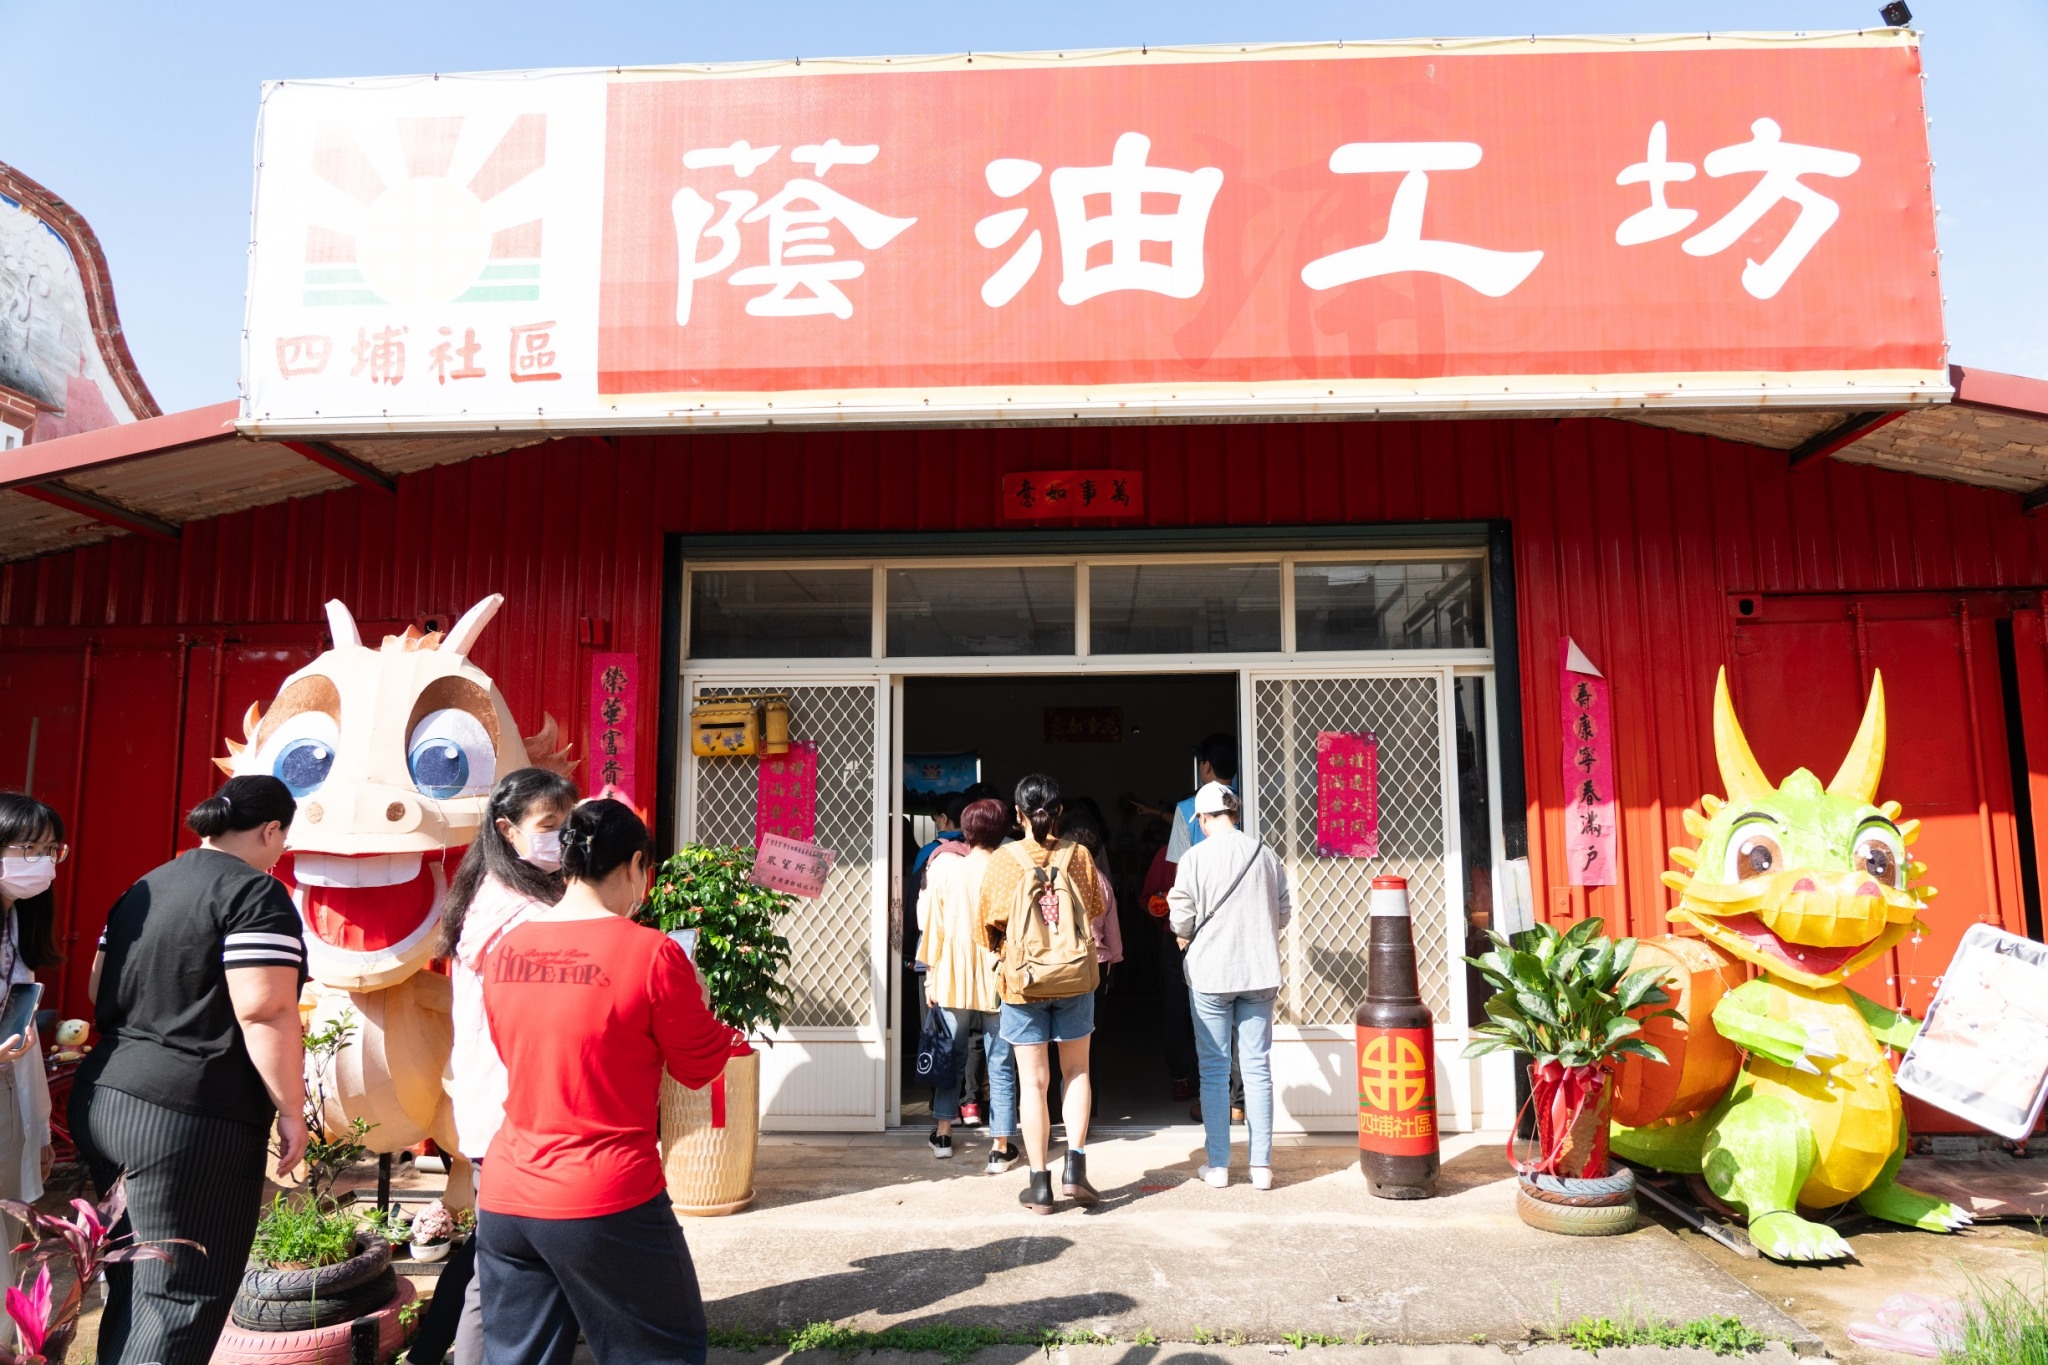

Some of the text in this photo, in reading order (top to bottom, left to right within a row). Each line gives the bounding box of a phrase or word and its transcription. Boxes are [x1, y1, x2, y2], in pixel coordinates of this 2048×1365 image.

[672, 117, 1862, 327] 蔭油工坊
[275, 320, 563, 386] 四埔社區
[1360, 1111, 1432, 1139] 四埔社區
